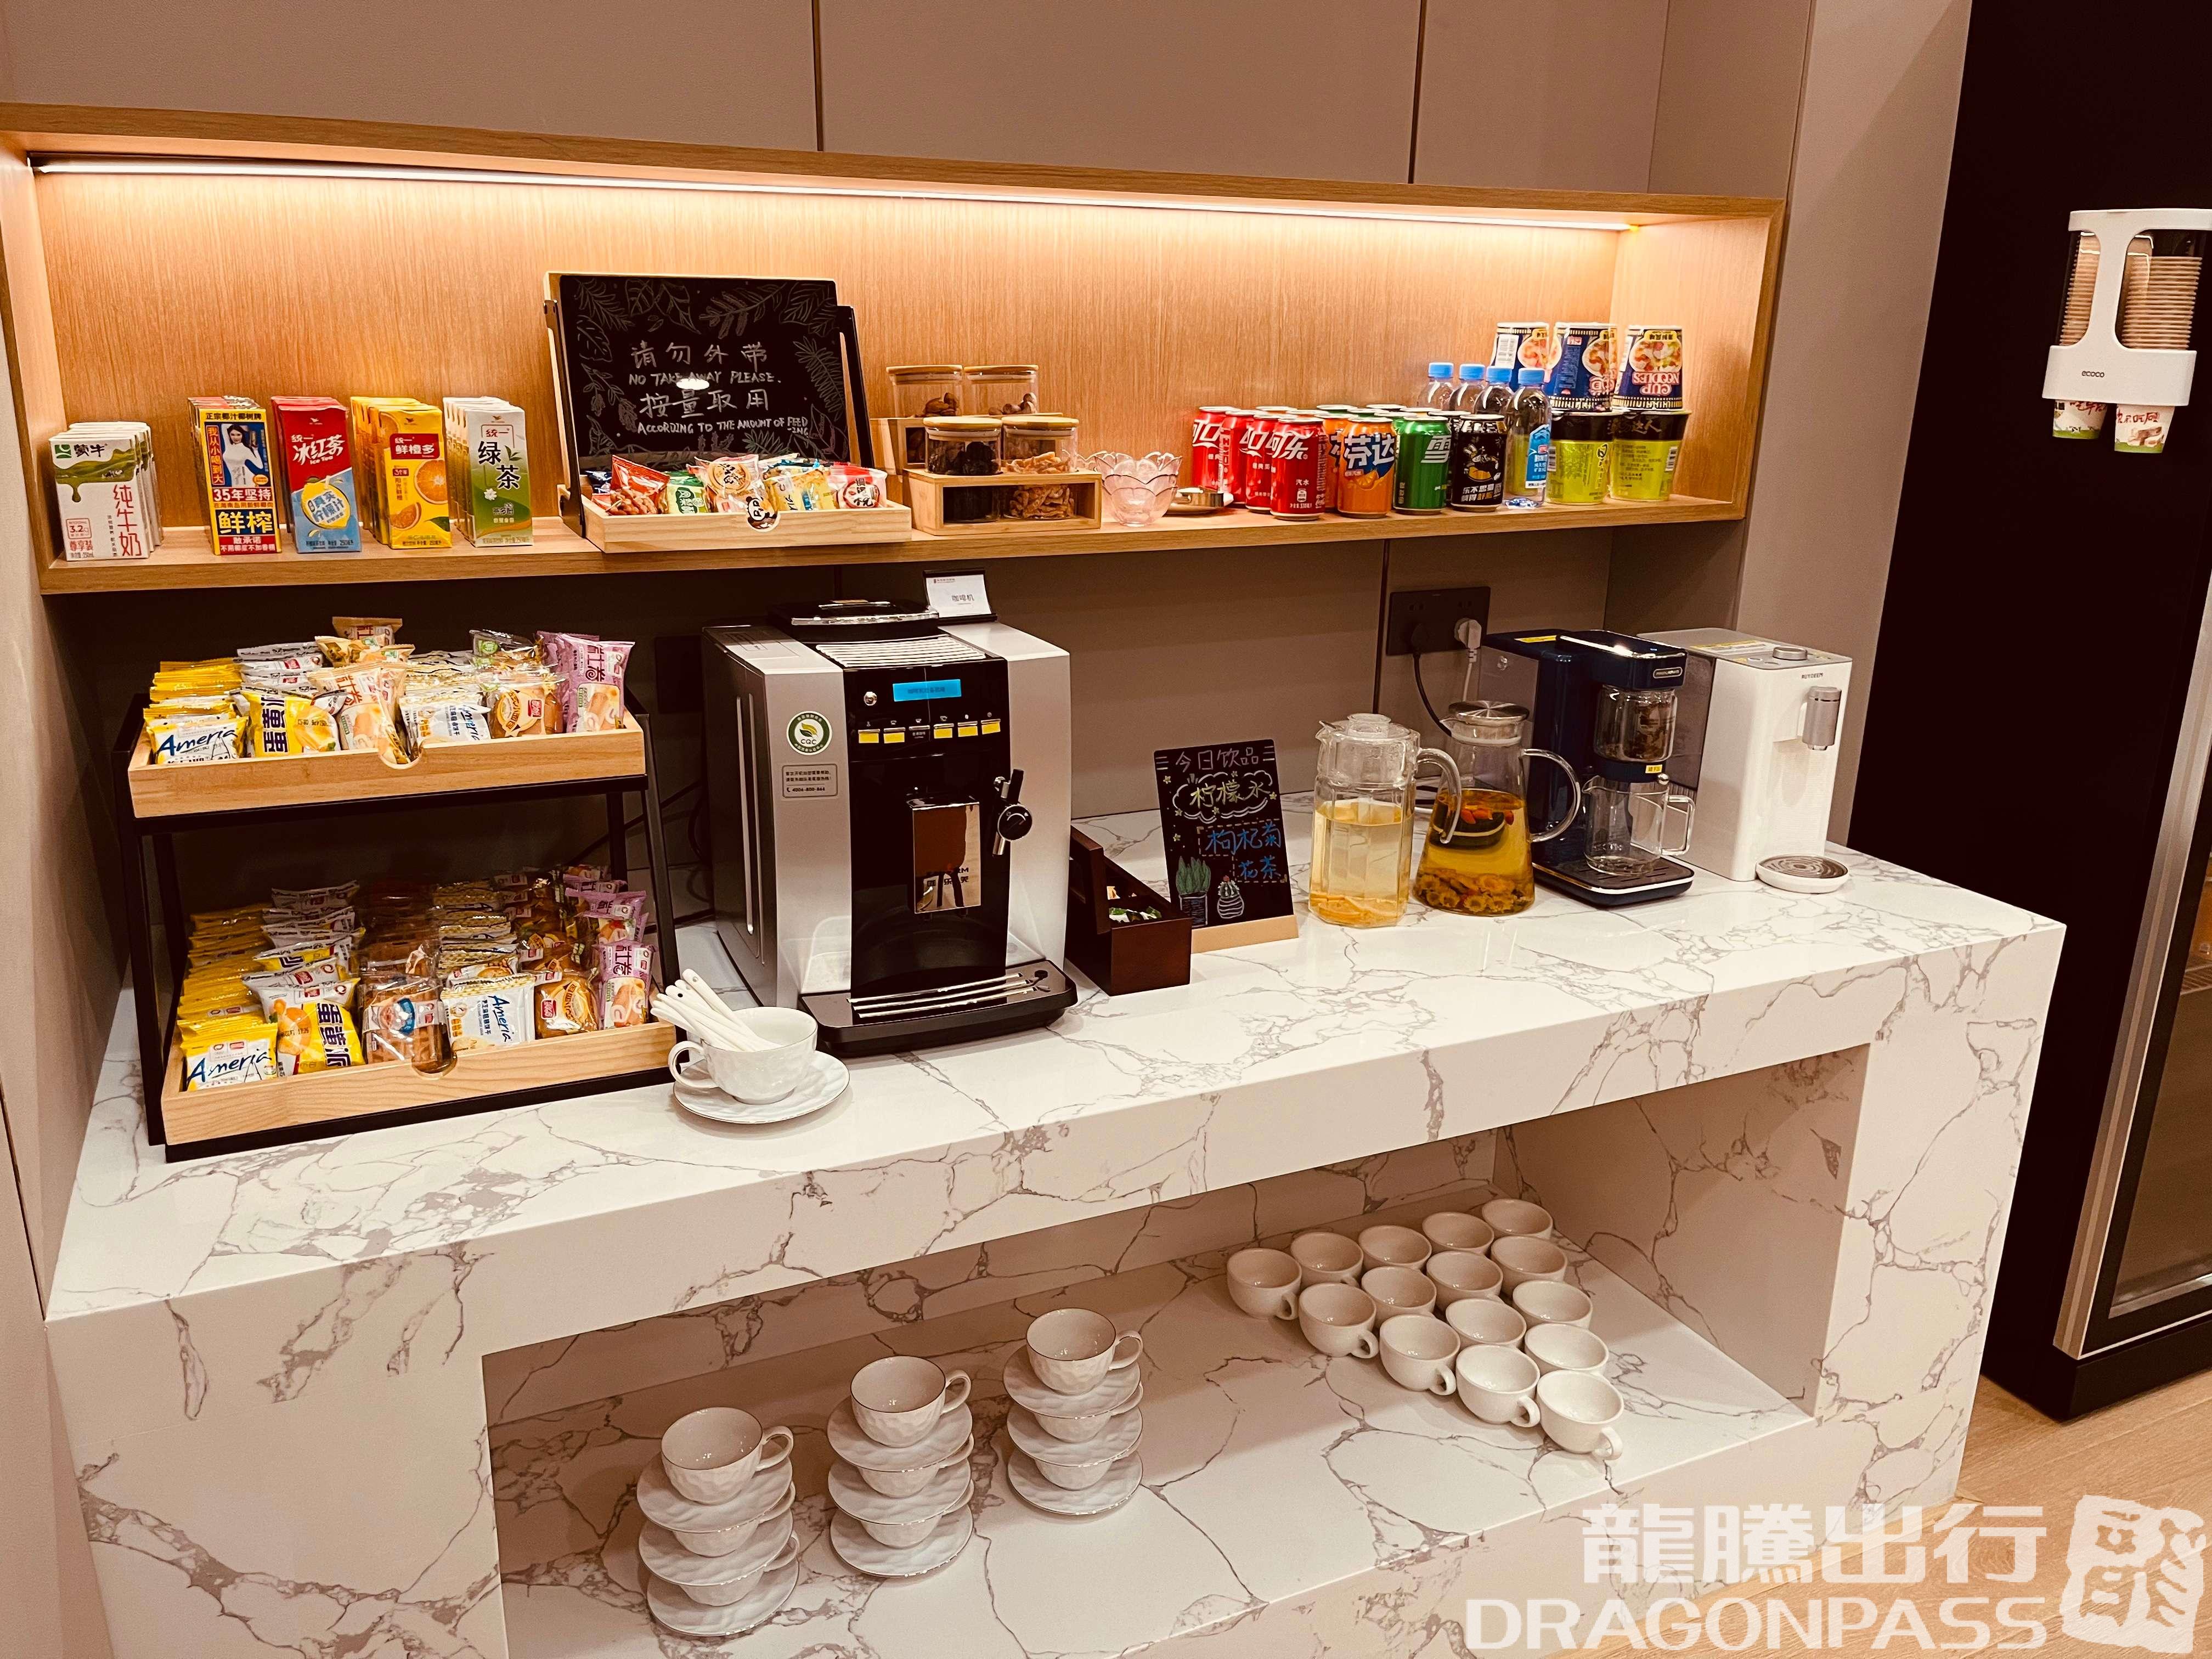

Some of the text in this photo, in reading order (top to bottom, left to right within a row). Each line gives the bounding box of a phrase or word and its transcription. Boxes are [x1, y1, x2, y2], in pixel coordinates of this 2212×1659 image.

[631, 340, 767, 373] 请勿外带
[629, 374, 646, 385] NO
[651, 371, 683, 386] TAKE
[1633, 373, 1680, 395] CUP NOODLES
[639, 388, 769, 418] 按量取用
[486, 428, 509, 438] 统一
[637, 416, 808, 435] ACCORDING TO THE AMOUNT OF FEED
[74, 444, 106, 458] 蒙牛
[292, 435, 346, 465] 冰红茶
[396, 444, 435, 455] 鲜橙多
[1344, 434, 1395, 469] 芬达
[478, 441, 521, 489] 绿茶
[213, 488, 272, 501] 35年坚持
[113, 484, 142, 556] 纯牛奶
[218, 511, 273, 534] 鲜榨
[157, 727, 238, 756] Ameria
[1176, 747, 1259, 772] 今日饮品
[1190, 780, 1271, 809] 柠檬水
[1205, 821, 1282, 856] 枸杞菊
[1238, 855, 1281, 879] 花茶
[488, 995, 512, 1042] Ameria
[317, 1002, 351, 1067] 蛋黄派
[187, 1048, 272, 1083] Ameria
